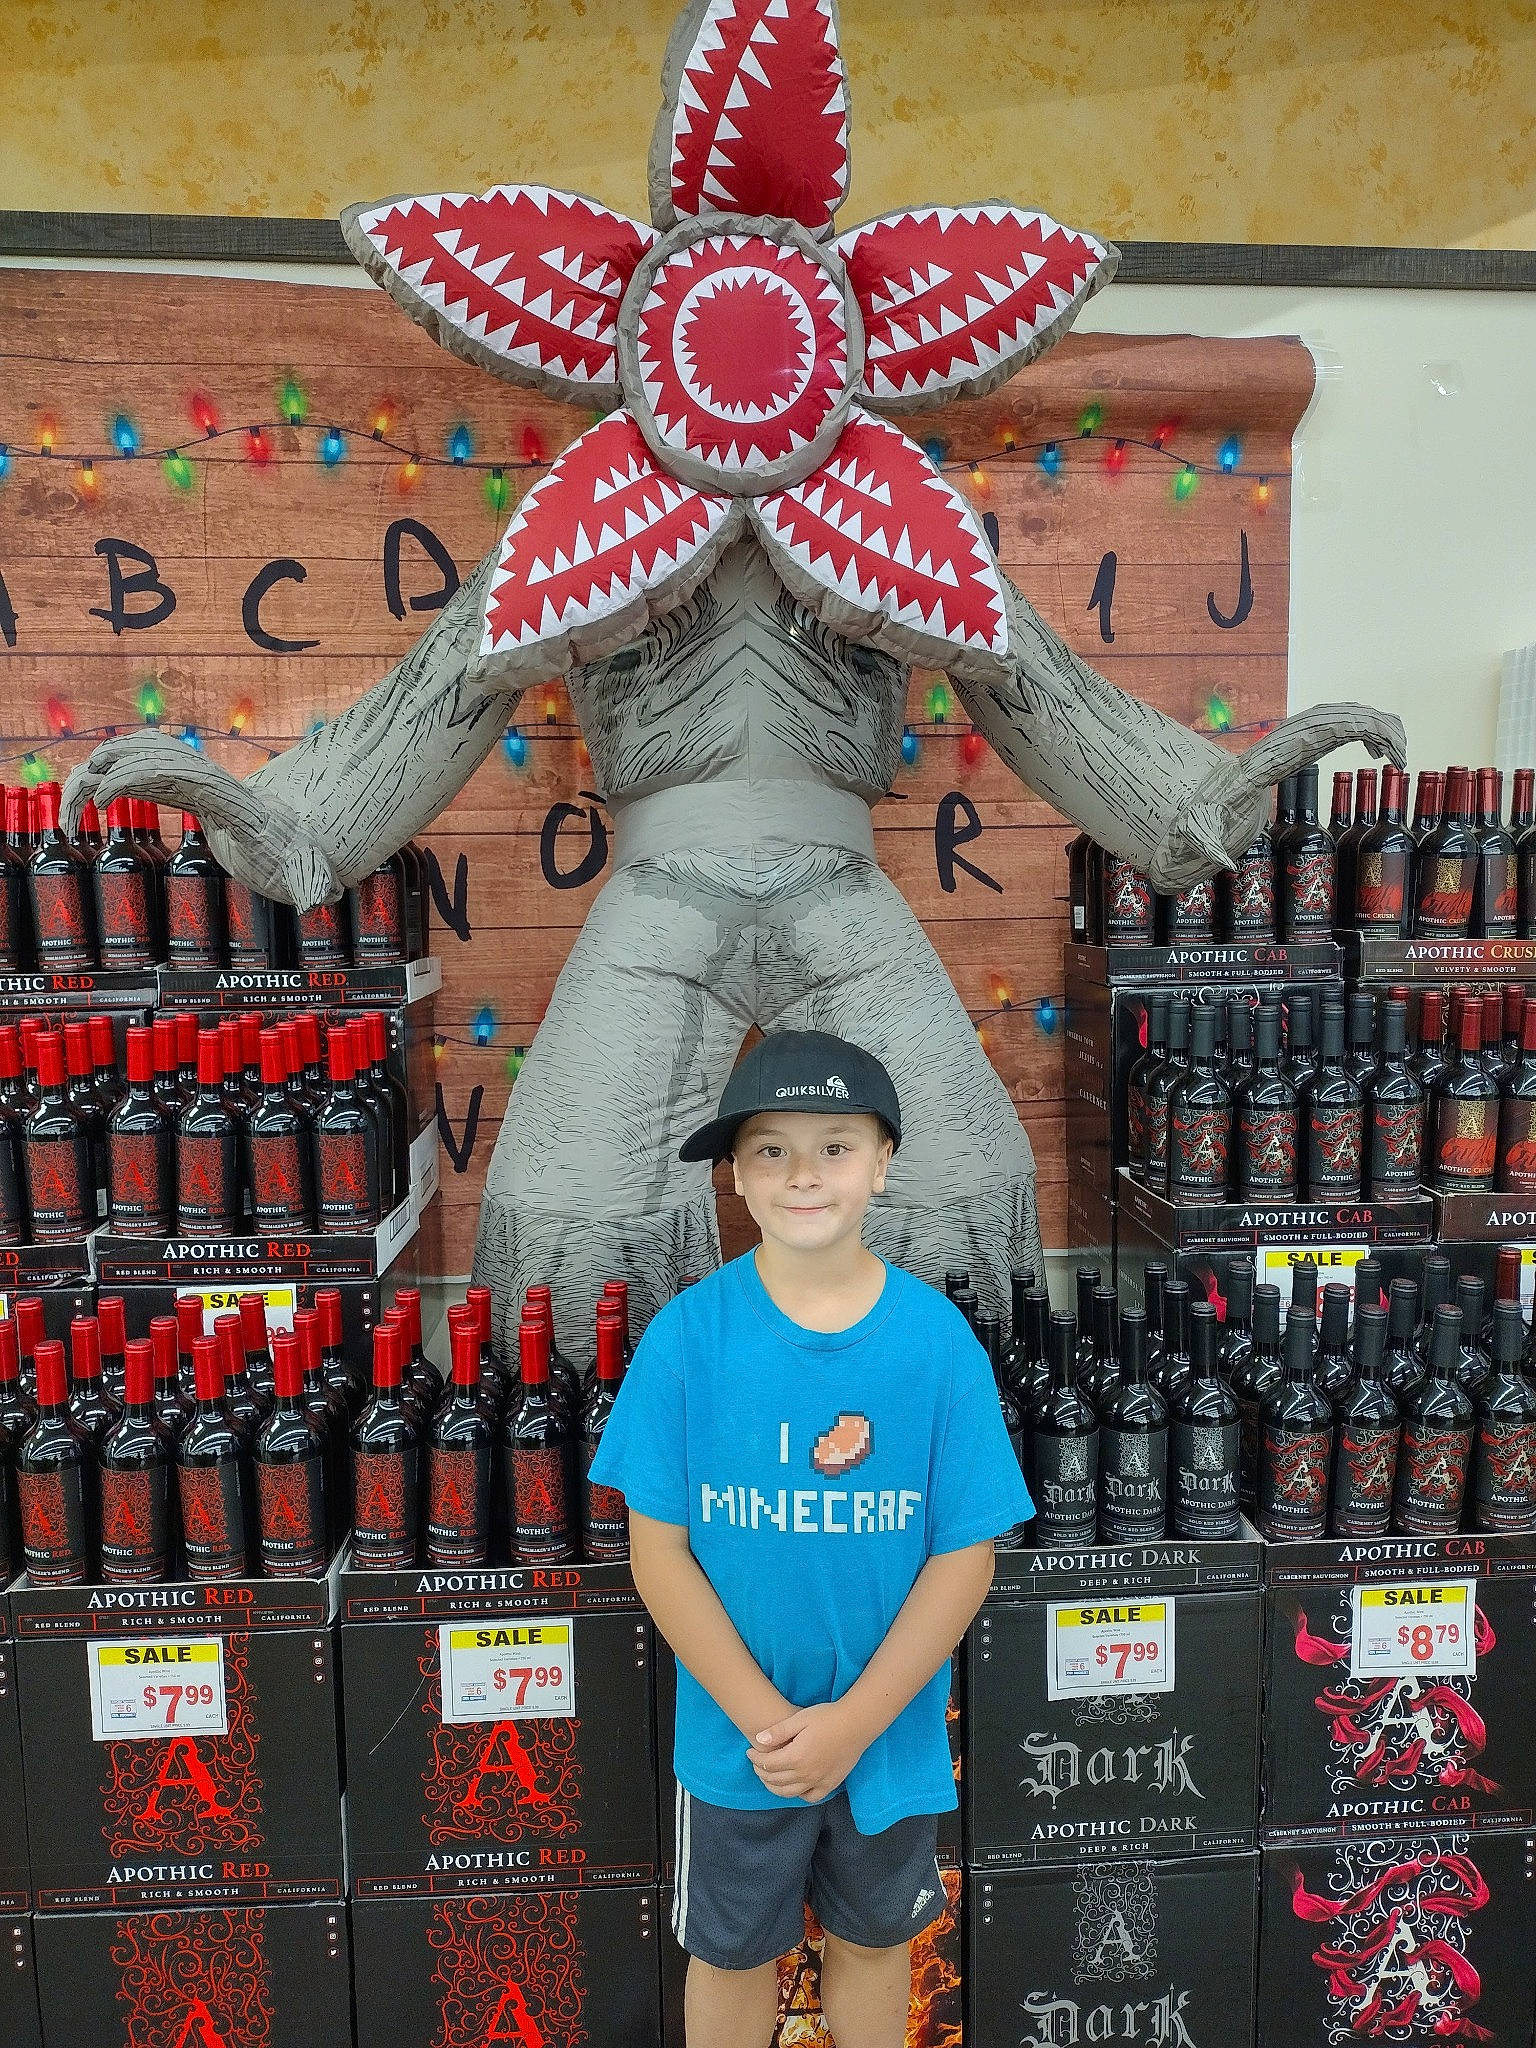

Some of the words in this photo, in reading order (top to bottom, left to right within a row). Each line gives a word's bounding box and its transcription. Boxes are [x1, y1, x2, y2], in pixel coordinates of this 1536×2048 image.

[89, 537, 176, 636] B
[242, 559, 321, 653] C
[383, 517, 461, 622] D
[1206, 528, 1254, 629] J
[424, 846, 473, 942] N
[540, 802, 609, 890] O
[935, 791, 1005, 895] R
[1418, 915, 1447, 925] APOTHIC
[1166, 949, 1248, 964] APOTHIC
[1254, 947, 1288, 962] CAB
[1405, 945, 1485, 960] APOTHIC
[1188, 970, 1223, 978] SMOOTH
[1434, 966, 1471, 974] VELVETY
[52, 975, 94, 990] RED
[215, 973, 302, 989] APOTHIC
[308, 971, 347, 987] RED
[243, 995, 267, 1003] RICH
[280, 994, 322, 1002] SMOOTH
[775, 1085, 850, 1100] QUIKSILVER
[435, 1082, 485, 1174] V
[1439, 1163, 1472, 1174] APOTHIC
[1180, 1174, 1213, 1183] APOTHIC
[1239, 1211, 1329, 1227] APOTHIC
[1336, 1208, 1373, 1223] CAB
[1264, 1233, 1301, 1241] SMOOTH
[162, 1243, 260, 1259] APOTHIC
[267, 1241, 312, 1258] RED
[193, 1267, 221, 1275] RICH
[236, 1266, 283, 1274] SMOOTH
[779, 1422, 790, 1464] I
[1181, 1497, 1216, 1509] APOTHIC
[1406, 1496, 1446, 1510] APOTHIC
[1491, 1493, 1529, 1503] APOTHIC
[701, 1483, 922, 1534] MINECRAF
[1106, 1503, 1141, 1515] APOTHIC
[1272, 1502, 1310, 1514] APOTHIC
[1349, 1500, 1385, 1509] APOTHIC
[515, 1526, 550, 1536] APOTHIC
[589, 1521, 625, 1530] APOTHIC
[355, 1529, 387, 1540] APOTHIC
[1338, 1543, 1437, 1562] APOTHIC
[1445, 1540, 1486, 1557] CAB
[1029, 1551, 1133, 1572] APOTHIC
[1141, 1549, 1202, 1567] DARK
[1206, 1572, 1249, 1580] CALIFORNIA
[1364, 1568, 1405, 1578] SMOOTH
[1416, 1564, 1480, 1575] FULL-BODIED
[416, 1573, 524, 1593] APOTHIC
[532, 1570, 582, 1588] RED
[1080, 1578, 1108, 1587] DEEP
[1113, 1578, 1119, 1586] &
[1124, 1576, 1151, 1586] RICH
[87, 1591, 196, 1610] APOTHIC
[204, 1588, 255, 1606] RED
[587, 1595, 636, 1603] CALIFORNIA
[1384, 1588, 1443, 1606] SALE
[450, 1601, 482, 1610] RICH
[485, 1600, 493, 1608] &
[497, 1598, 549, 1608] SMOOTH
[122, 1616, 153, 1627] RICH
[157, 1616, 165, 1625] &
[170, 1615, 223, 1625] SMOOTH
[261, 1613, 312, 1622] CALIFORNIA
[1080, 1607, 1141, 1625] SALE
[54, 1621, 81, 1629] BLEND
[476, 1628, 543, 1648] SALE
[124, 1646, 192, 1665] SALE
[457, 1719, 552, 1807] A
[135, 1736, 233, 1819] A
[1326, 1799, 1424, 1818] APOTHIC
[1431, 1795, 1472, 1811] CAB
[1351, 1822, 1392, 1832] SMOOTH
[1403, 1818, 1466, 1829] FULL-BODIED
[1482, 1816, 1523, 1824] CALIFORNIA
[1031, 1820, 1131, 1840] APOTHIC
[1139, 1816, 1198, 1833] DARK
[1269, 1829, 1300, 1837] CABERNET
[1301, 1827, 1337, 1836] SAUVIGNON
[1203, 1837, 1245, 1847] CALIFORNIA
[1080, 1846, 1107, 1854] DEEP
[1112, 1845, 1118, 1853] &
[1121, 1843, 1149, 1852] RICH
[425, 1851, 531, 1871] APOTHIC
[539, 1848, 587, 1865] RED
[106, 1864, 214, 1884] APOTHIC
[221, 1861, 270, 1879] RED
[592, 1871, 641, 1880] CALIFORNIA
[458, 1877, 488, 1887] RICH
[492, 1877, 500, 1885] &
[504, 1874, 556, 1884] SMOOTH
[141, 1890, 171, 1899] RICH
[176, 1889, 183, 1898] &
[188, 1887, 239, 1897] SMOOTH
[277, 1886, 326, 1894] CALIFORNIA
[391, 1883, 418, 1891] BLEND
[73, 1895, 100, 1903] BLEND
[911, 1889, 936, 1919] adidas
[1092, 1910, 1142, 1963] A
